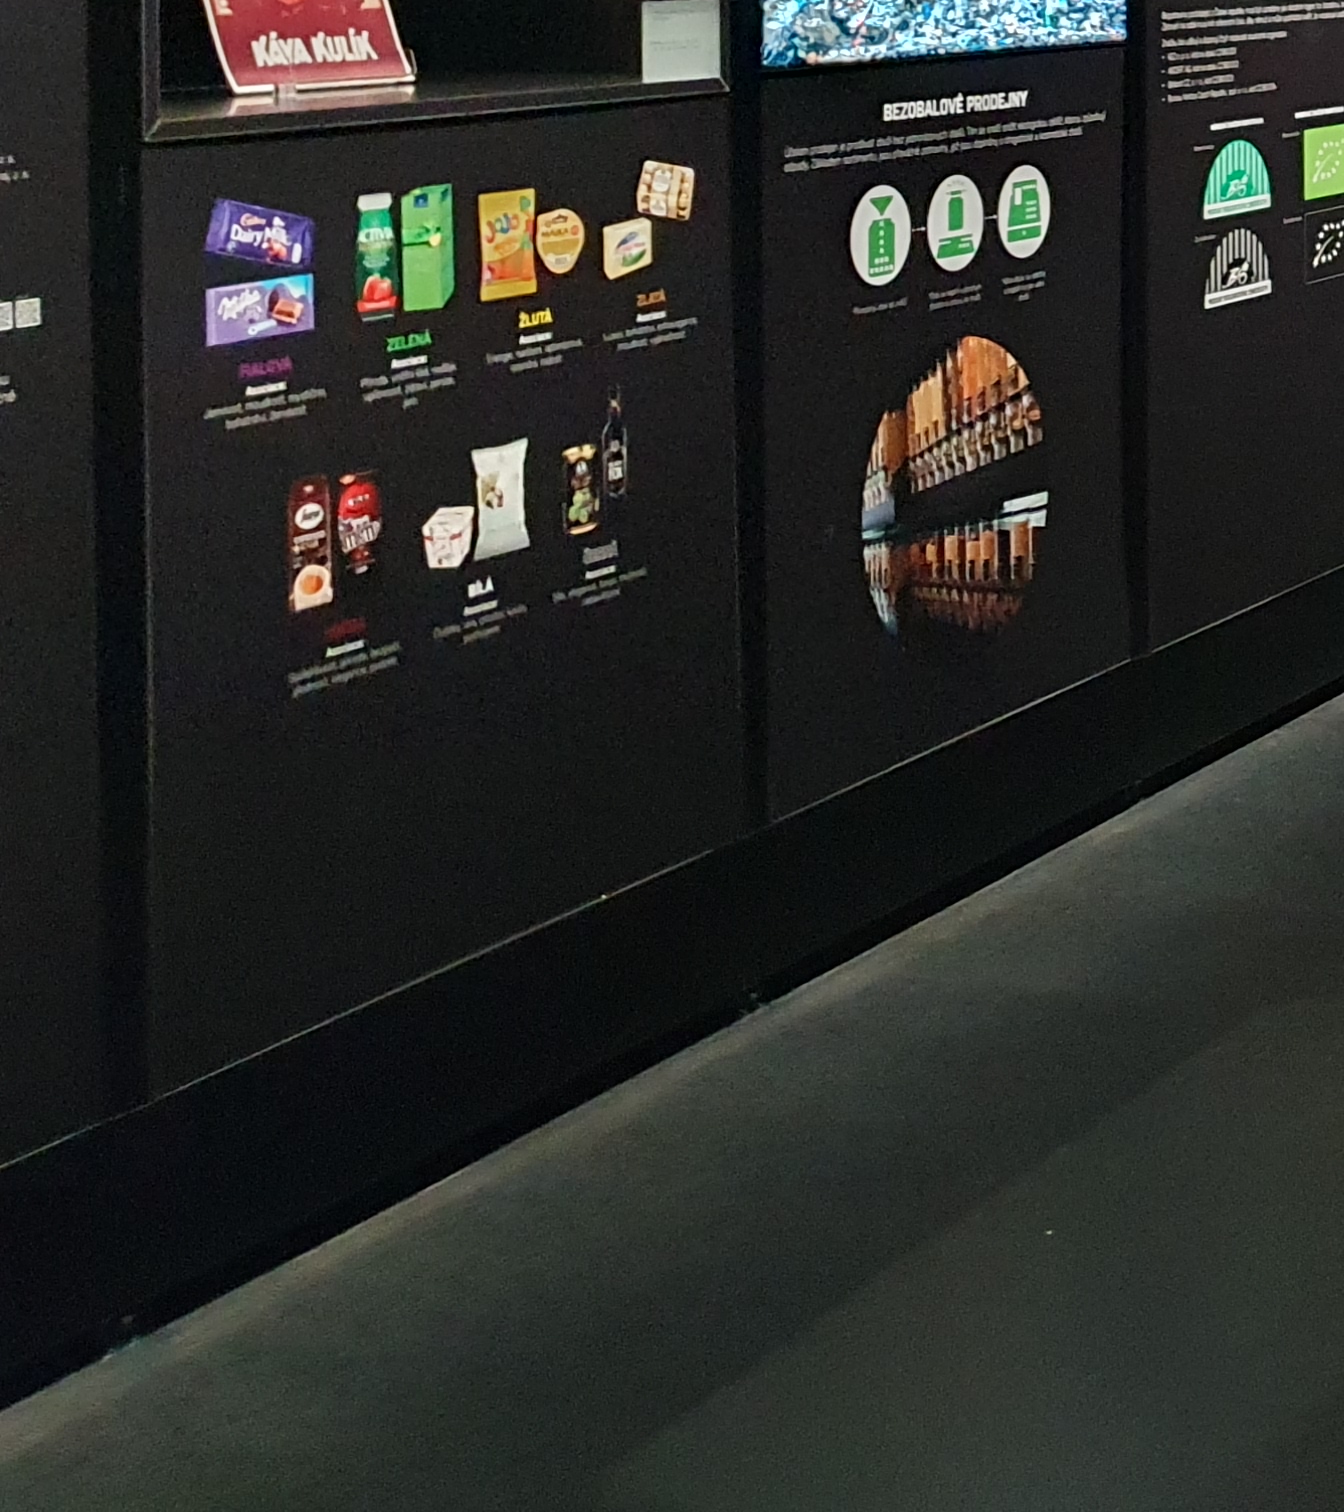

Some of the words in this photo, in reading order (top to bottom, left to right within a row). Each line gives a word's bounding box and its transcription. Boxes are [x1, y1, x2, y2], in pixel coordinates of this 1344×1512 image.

[251, 31, 313, 68] KÁVA
[310, 27, 378, 63] KULÍK
[883, 92, 964, 121] BEZOBALOVÉ
[966, 90, 1029, 113] PRODEJNY
[518, 306, 553, 329] ŽLUTÁ
